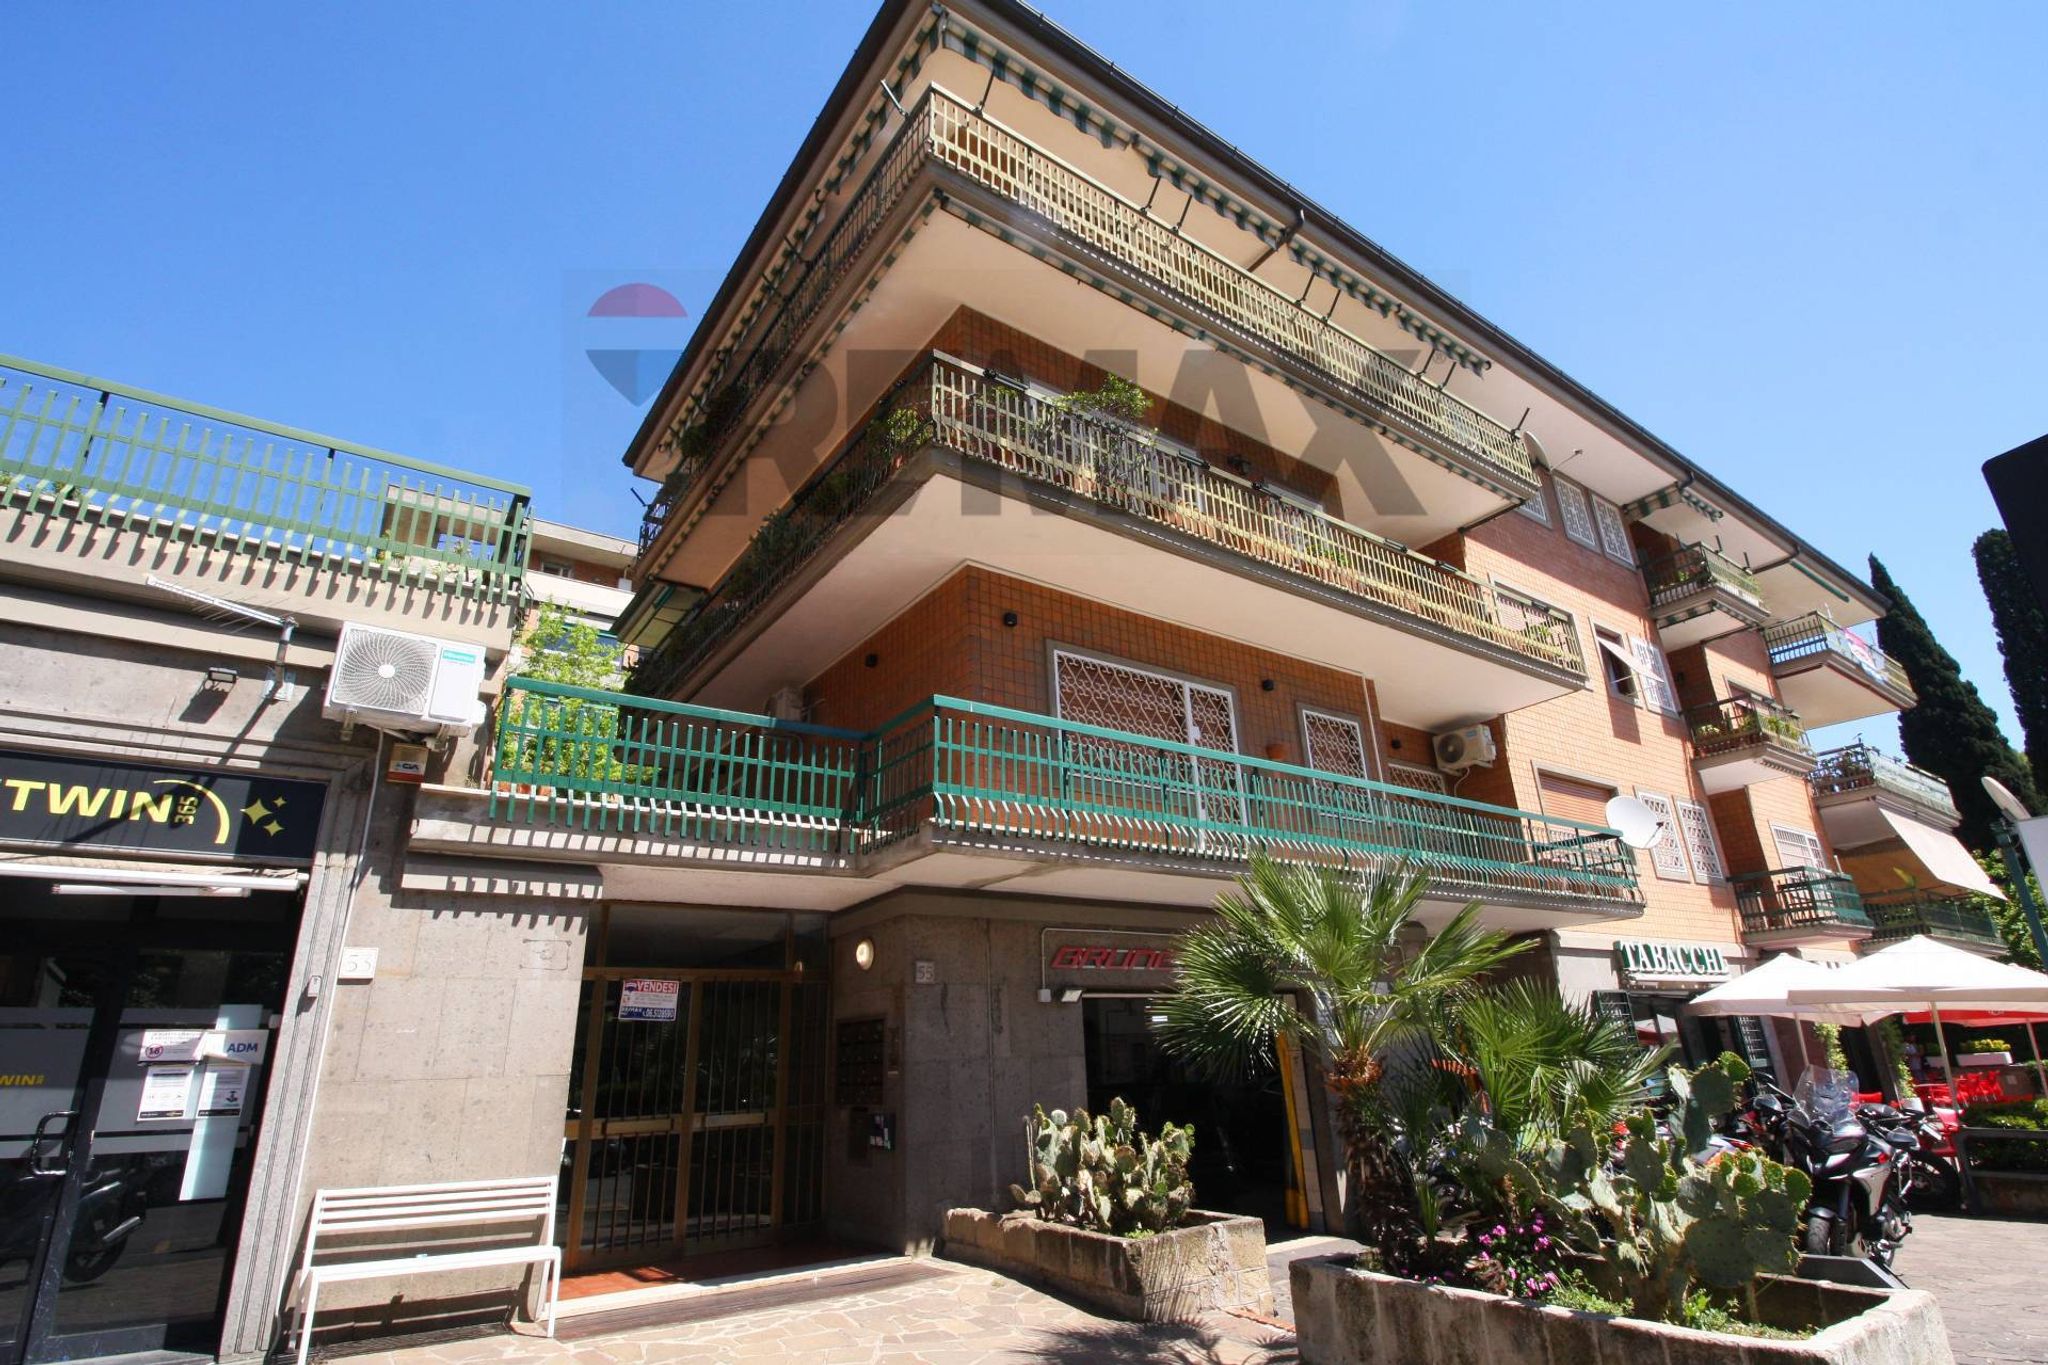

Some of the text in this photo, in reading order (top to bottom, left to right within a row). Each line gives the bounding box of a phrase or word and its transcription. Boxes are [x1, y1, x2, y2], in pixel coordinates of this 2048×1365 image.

[0, 779, 199, 825] TWIN 365
[1621, 941, 1728, 974] TABACCHI
[637, 981, 676, 993] VENDESI
[227, 1042, 258, 1053] ADM
